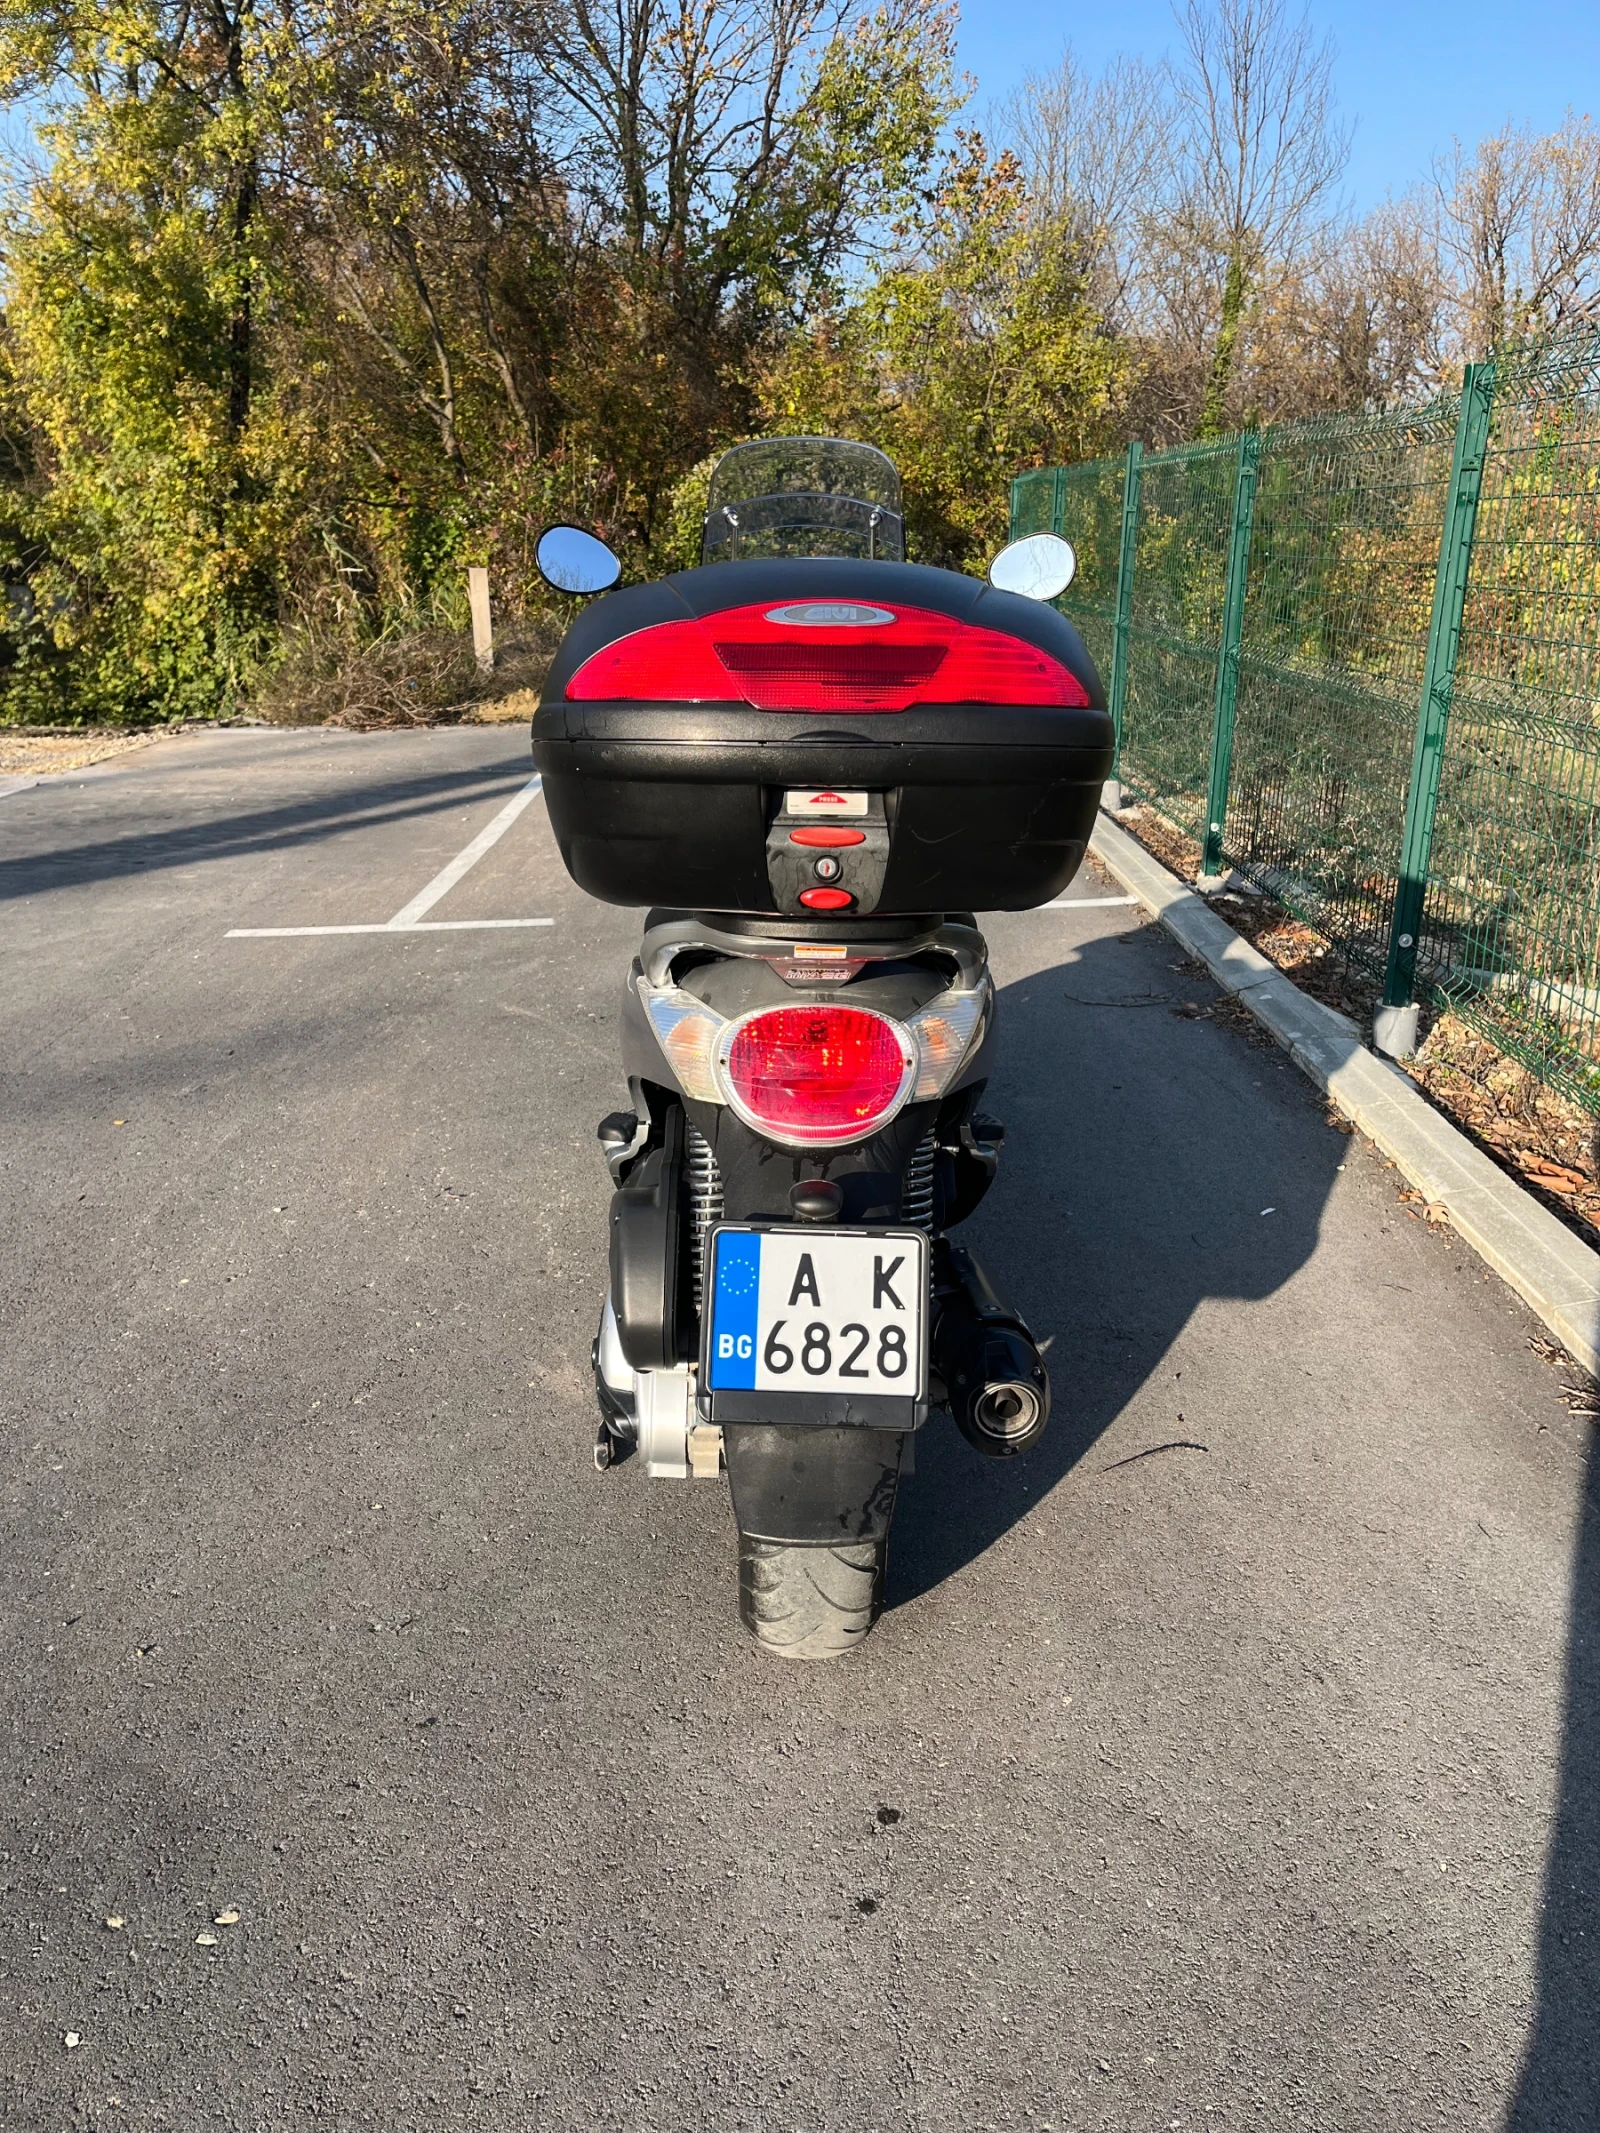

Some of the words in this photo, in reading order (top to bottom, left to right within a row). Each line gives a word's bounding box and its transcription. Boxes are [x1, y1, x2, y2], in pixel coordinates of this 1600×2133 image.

[804, 606, 857, 620] GIVI
[788, 1253, 821, 1307] A
[872, 1255, 906, 1310] K
[718, 1333, 752, 1359] BG
[763, 1320, 908, 1379] 6828
